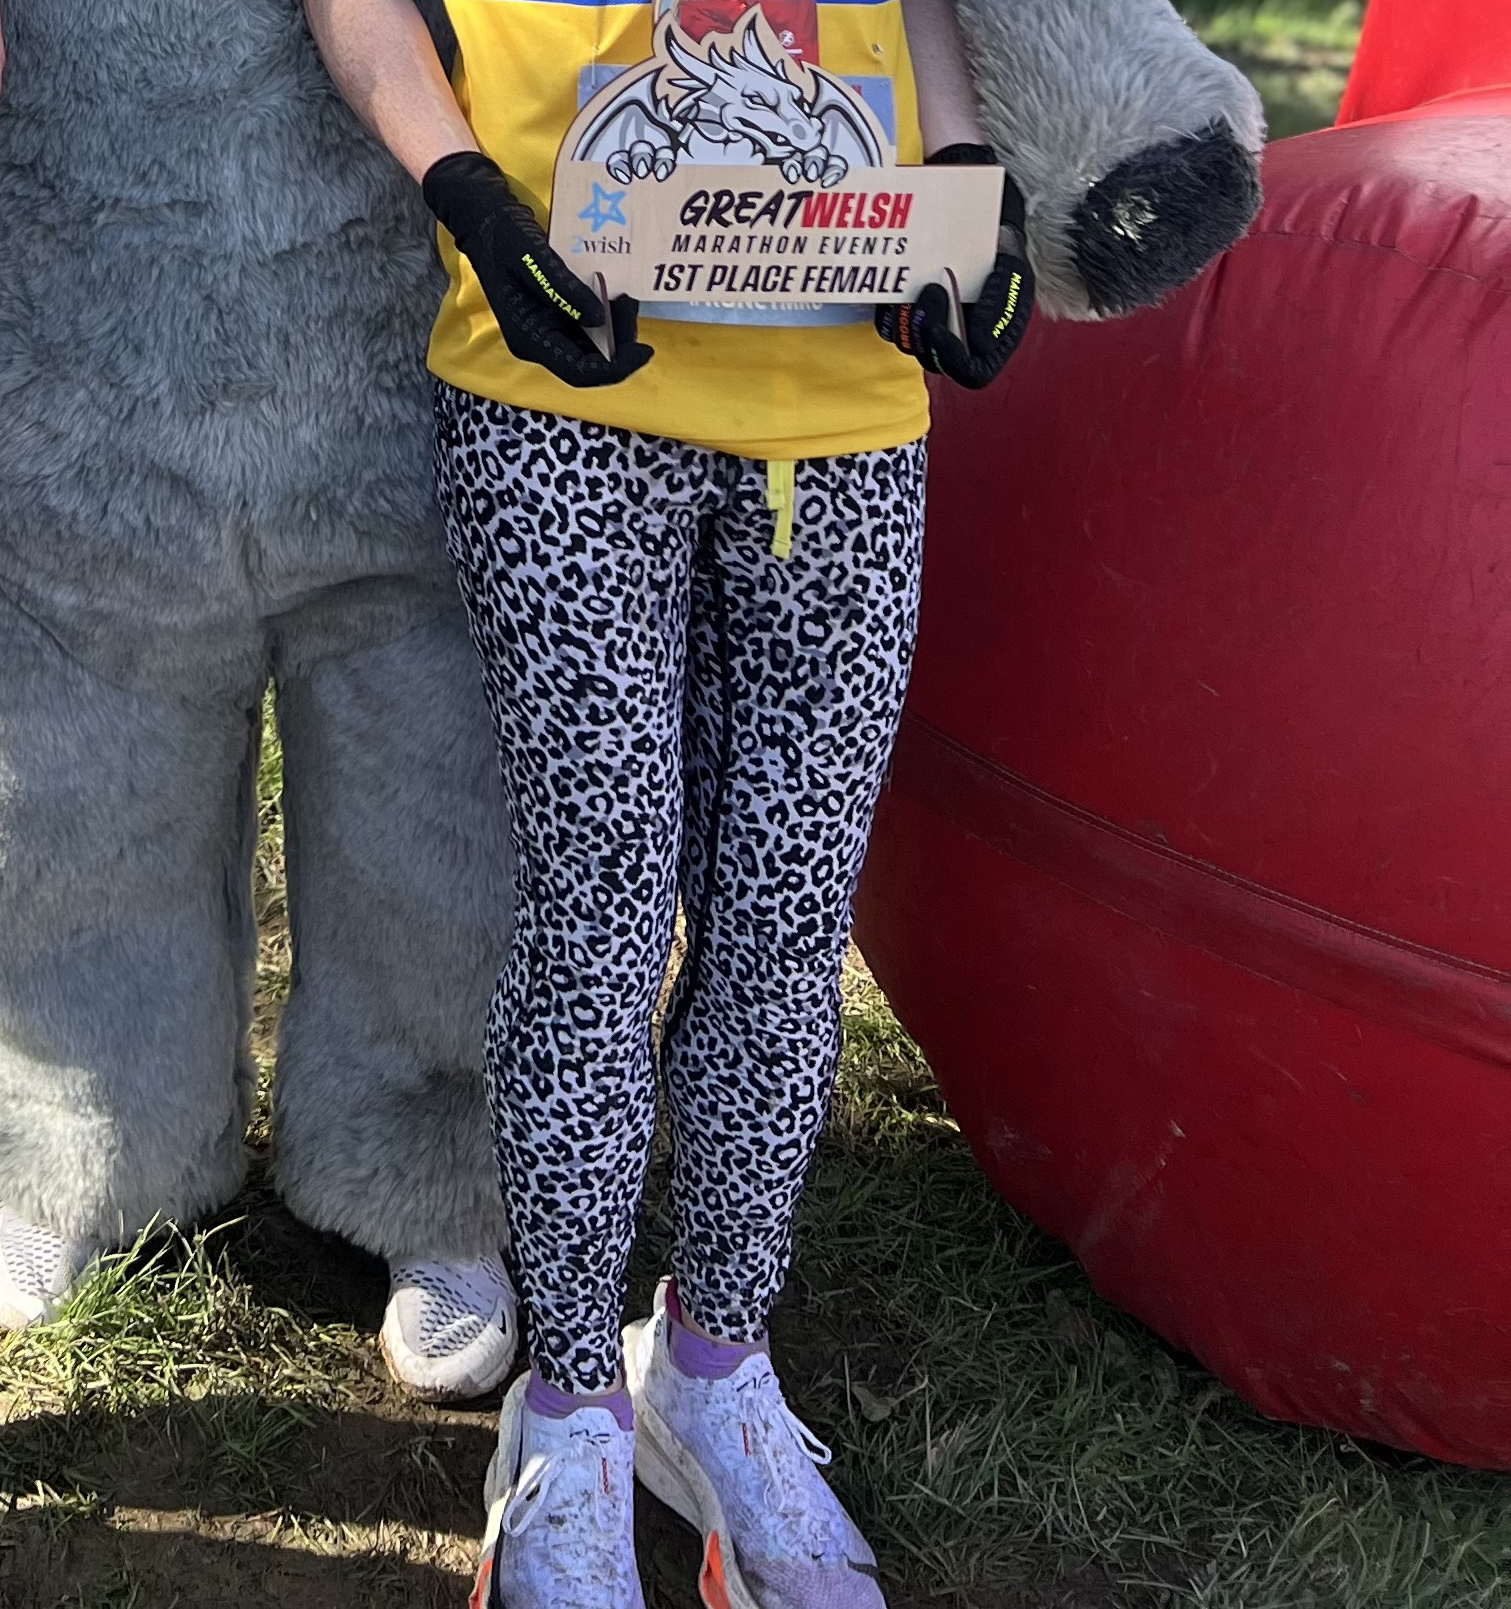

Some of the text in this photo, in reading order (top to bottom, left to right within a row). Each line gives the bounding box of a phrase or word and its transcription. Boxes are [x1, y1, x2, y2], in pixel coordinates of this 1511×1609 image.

[570, 234, 631, 255] 2wish
[671, 234, 909, 256] MARATHON EVENTS
[521, 253, 581, 321] MANHATTAN
[652, 263, 910, 294] 1ST PLACE FEMALE
[992, 272, 1022, 339] MANHATTAN
[898, 303, 912, 349] BROOKL
